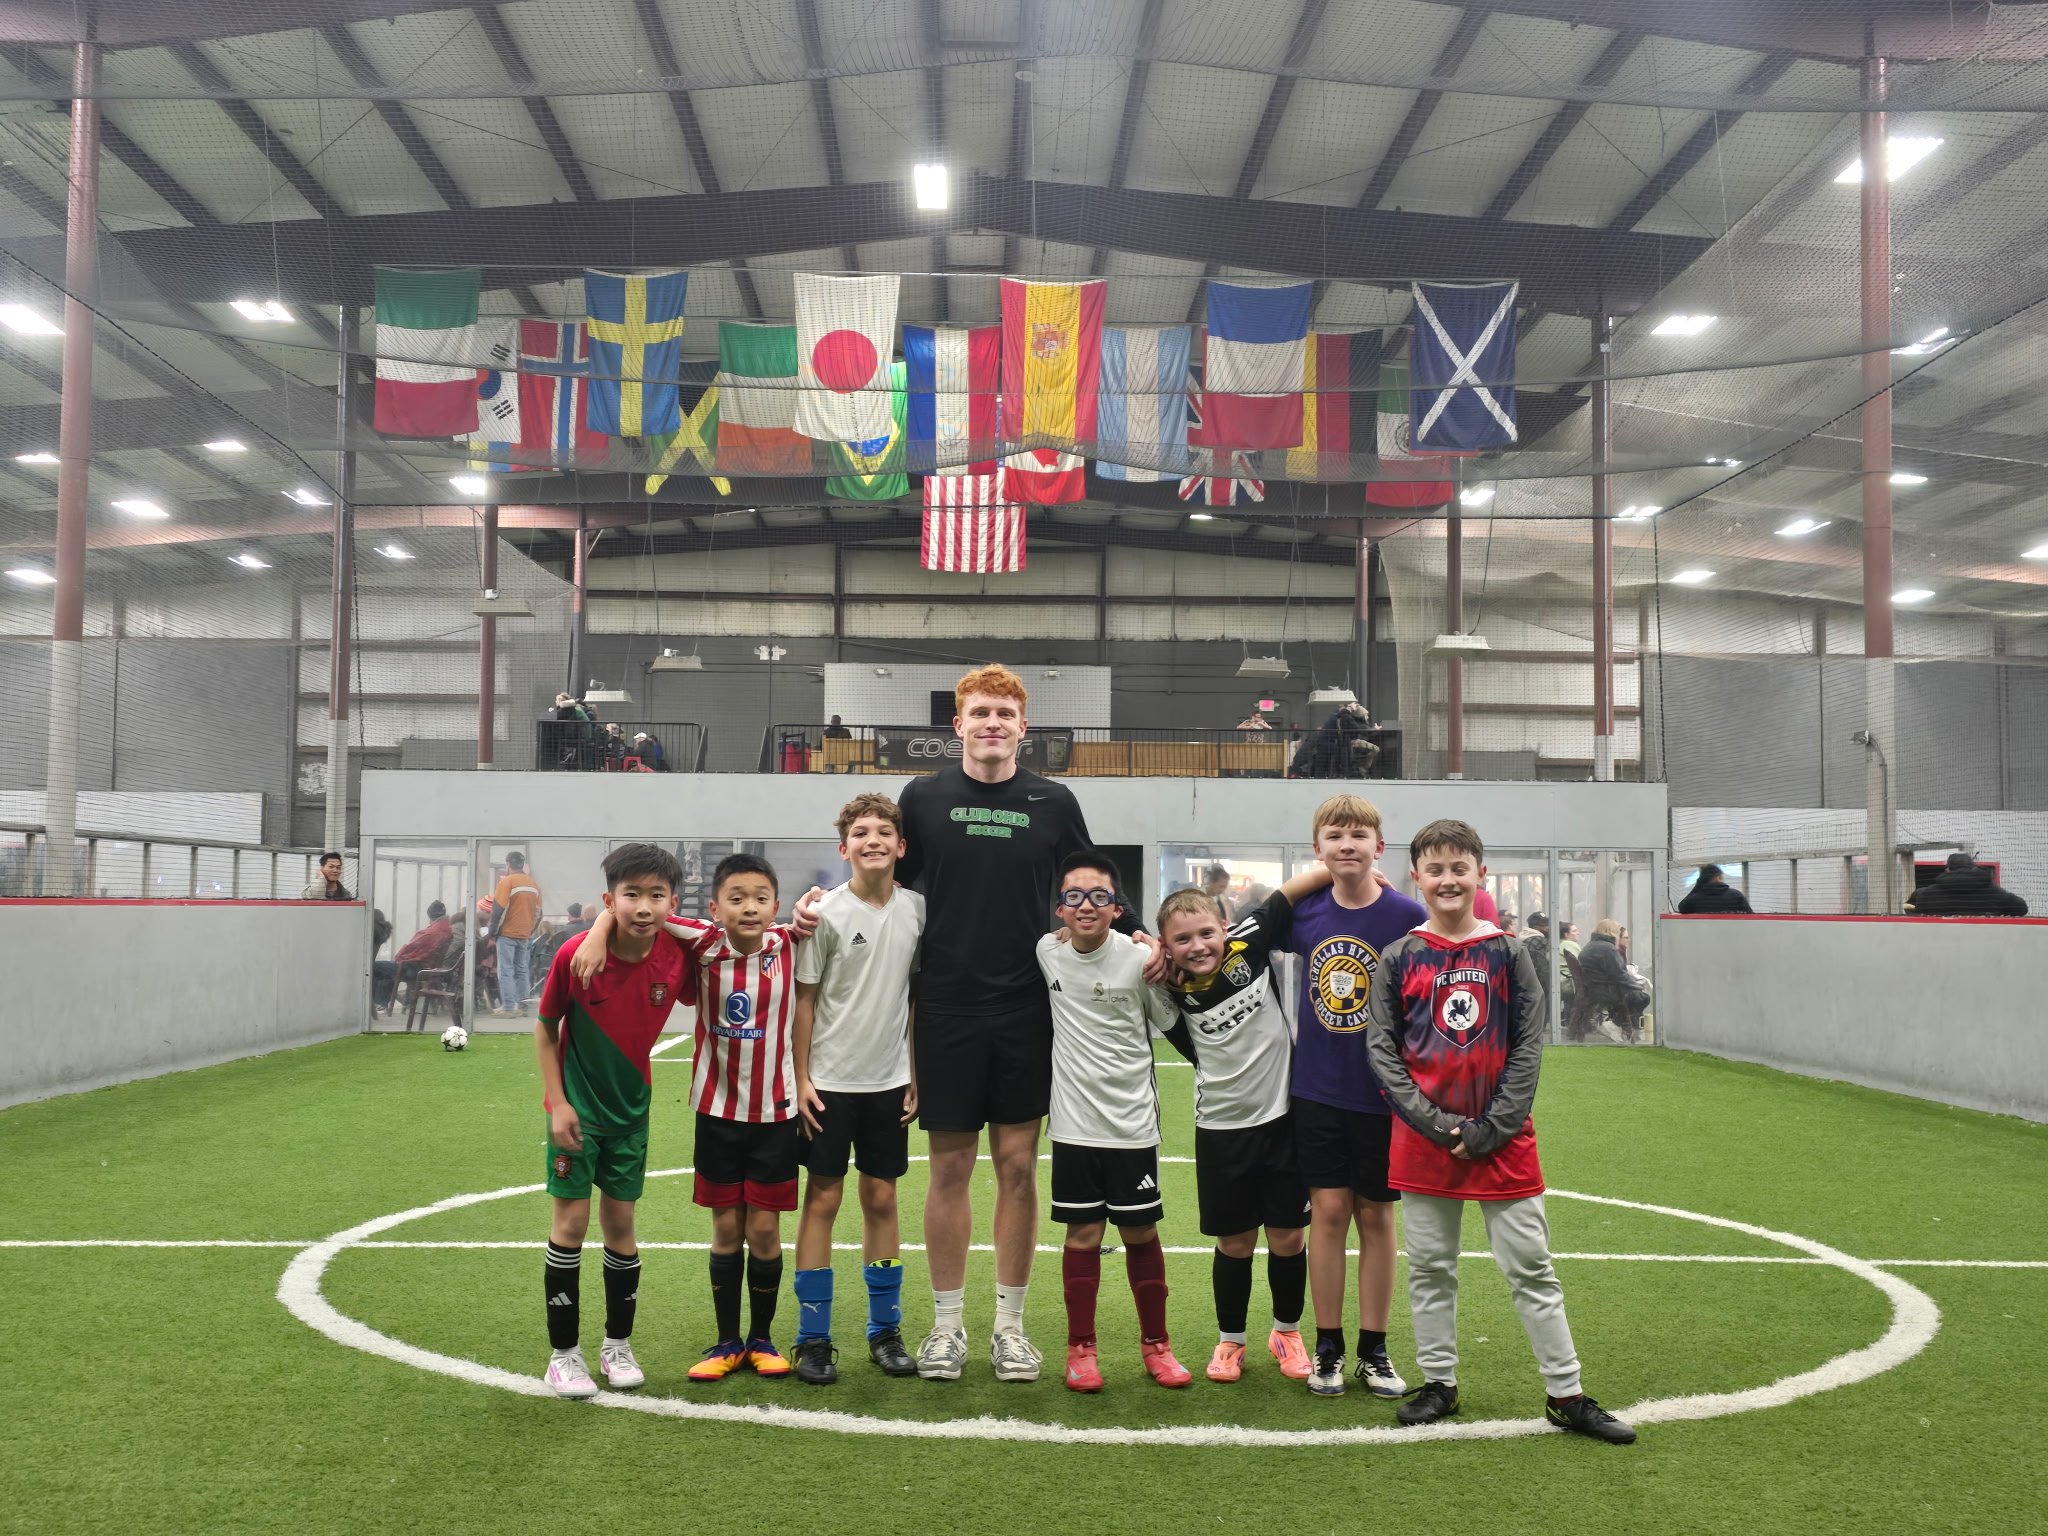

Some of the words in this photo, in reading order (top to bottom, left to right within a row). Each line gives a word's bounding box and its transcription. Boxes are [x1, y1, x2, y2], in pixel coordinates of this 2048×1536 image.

[907, 738, 1033, 758] coer
[950, 807, 991, 822] CLUB
[991, 809, 1029, 827] OHIO
[966, 824, 1012, 838] SOCCER
[1450, 971, 1486, 984] UNITED
[1200, 988, 1261, 1027] OLUMBUS
[1315, 998, 1342, 1026] SOCCER
[1347, 1007, 1368, 1026] CAM
[712, 1025, 745, 1038] RIYADH
[746, 1029, 763, 1038] AIR
